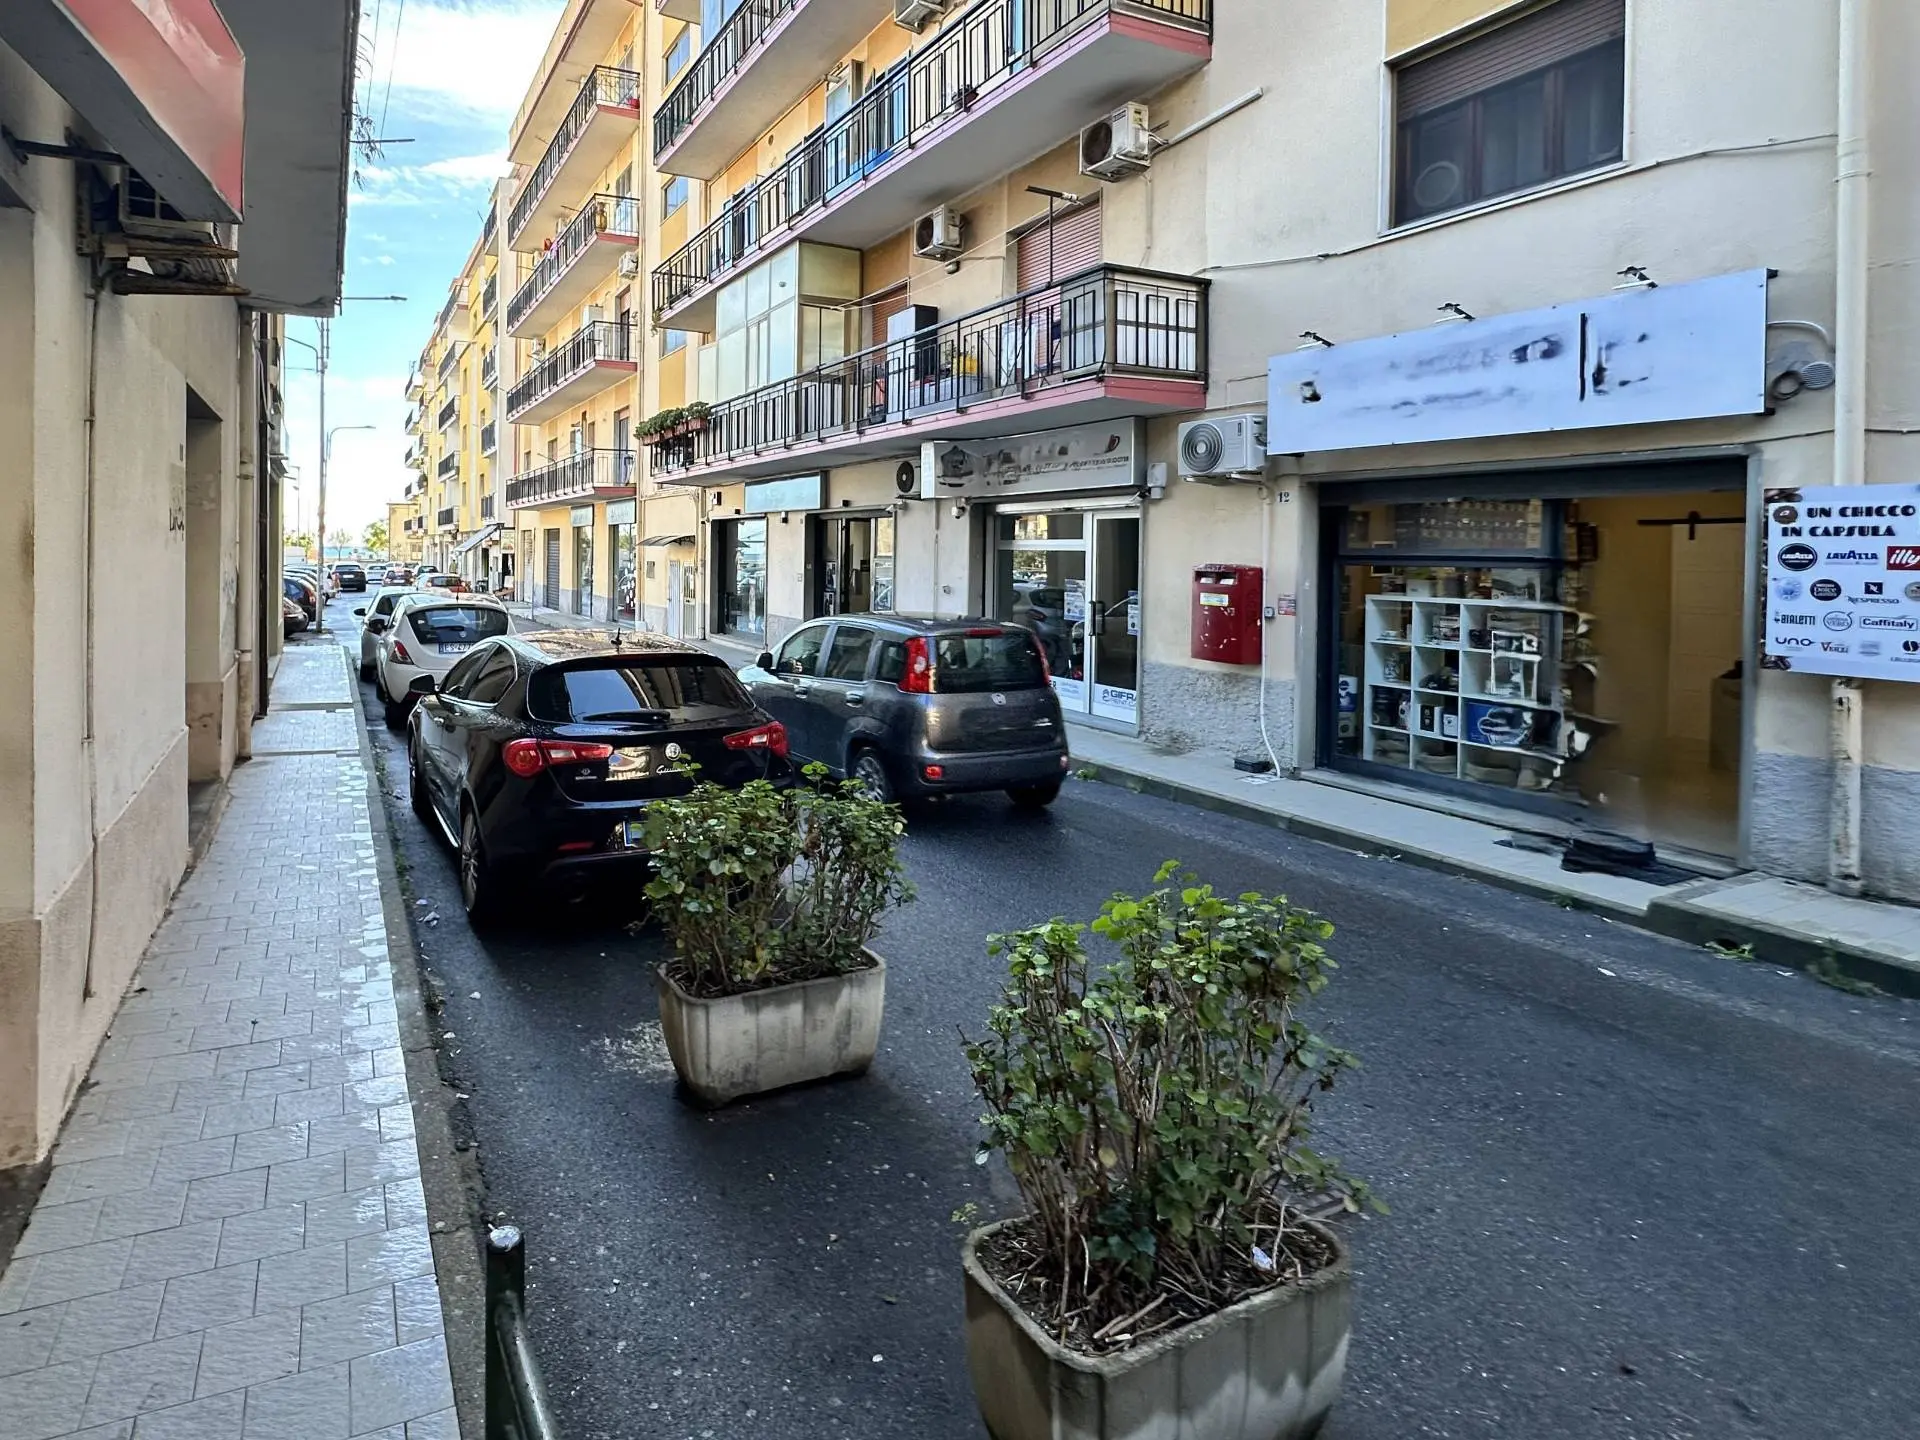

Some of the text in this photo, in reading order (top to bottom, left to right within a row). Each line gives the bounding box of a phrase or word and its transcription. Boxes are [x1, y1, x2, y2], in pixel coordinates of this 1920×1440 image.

[1279, 491, 1290, 503] 12
[1806, 505, 1916, 518] UN CHICCO
[1781, 525, 1896, 537] IN CAPSULA
[1826, 550, 1879, 560] LAVAZZA
[1889, 549, 1920, 568] illy
[1780, 614, 1816, 626] BIALETTI
[1863, 618, 1915, 629] Caffitaly
